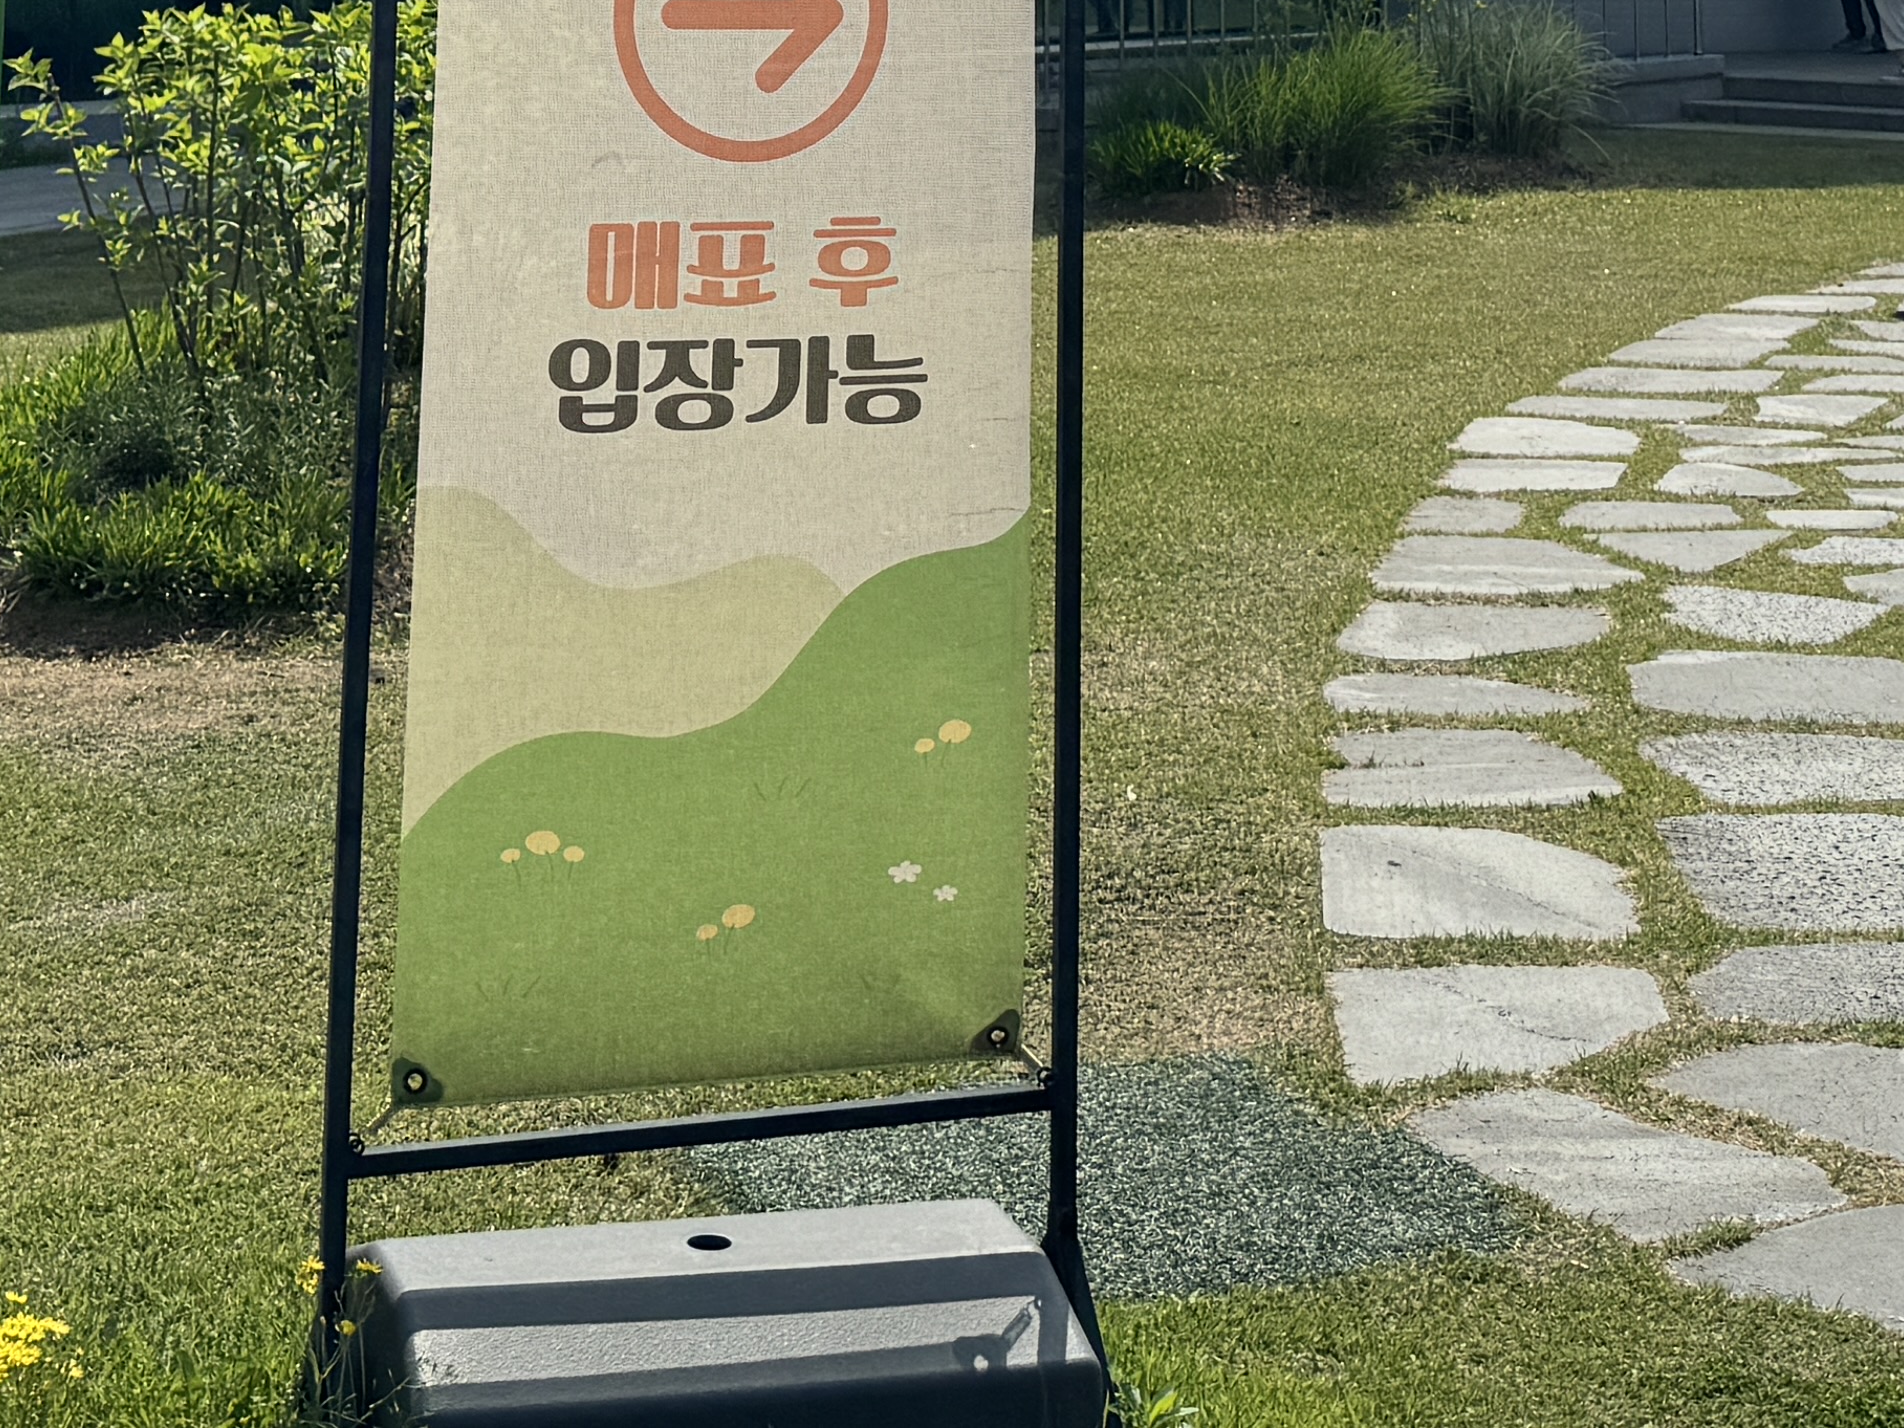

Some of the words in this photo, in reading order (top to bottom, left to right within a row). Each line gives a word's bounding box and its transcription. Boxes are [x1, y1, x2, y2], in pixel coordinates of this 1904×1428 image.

[586, 219, 777, 311] 매표
[809, 216, 899, 307] 후
[548, 333, 928, 434] 입장가능
